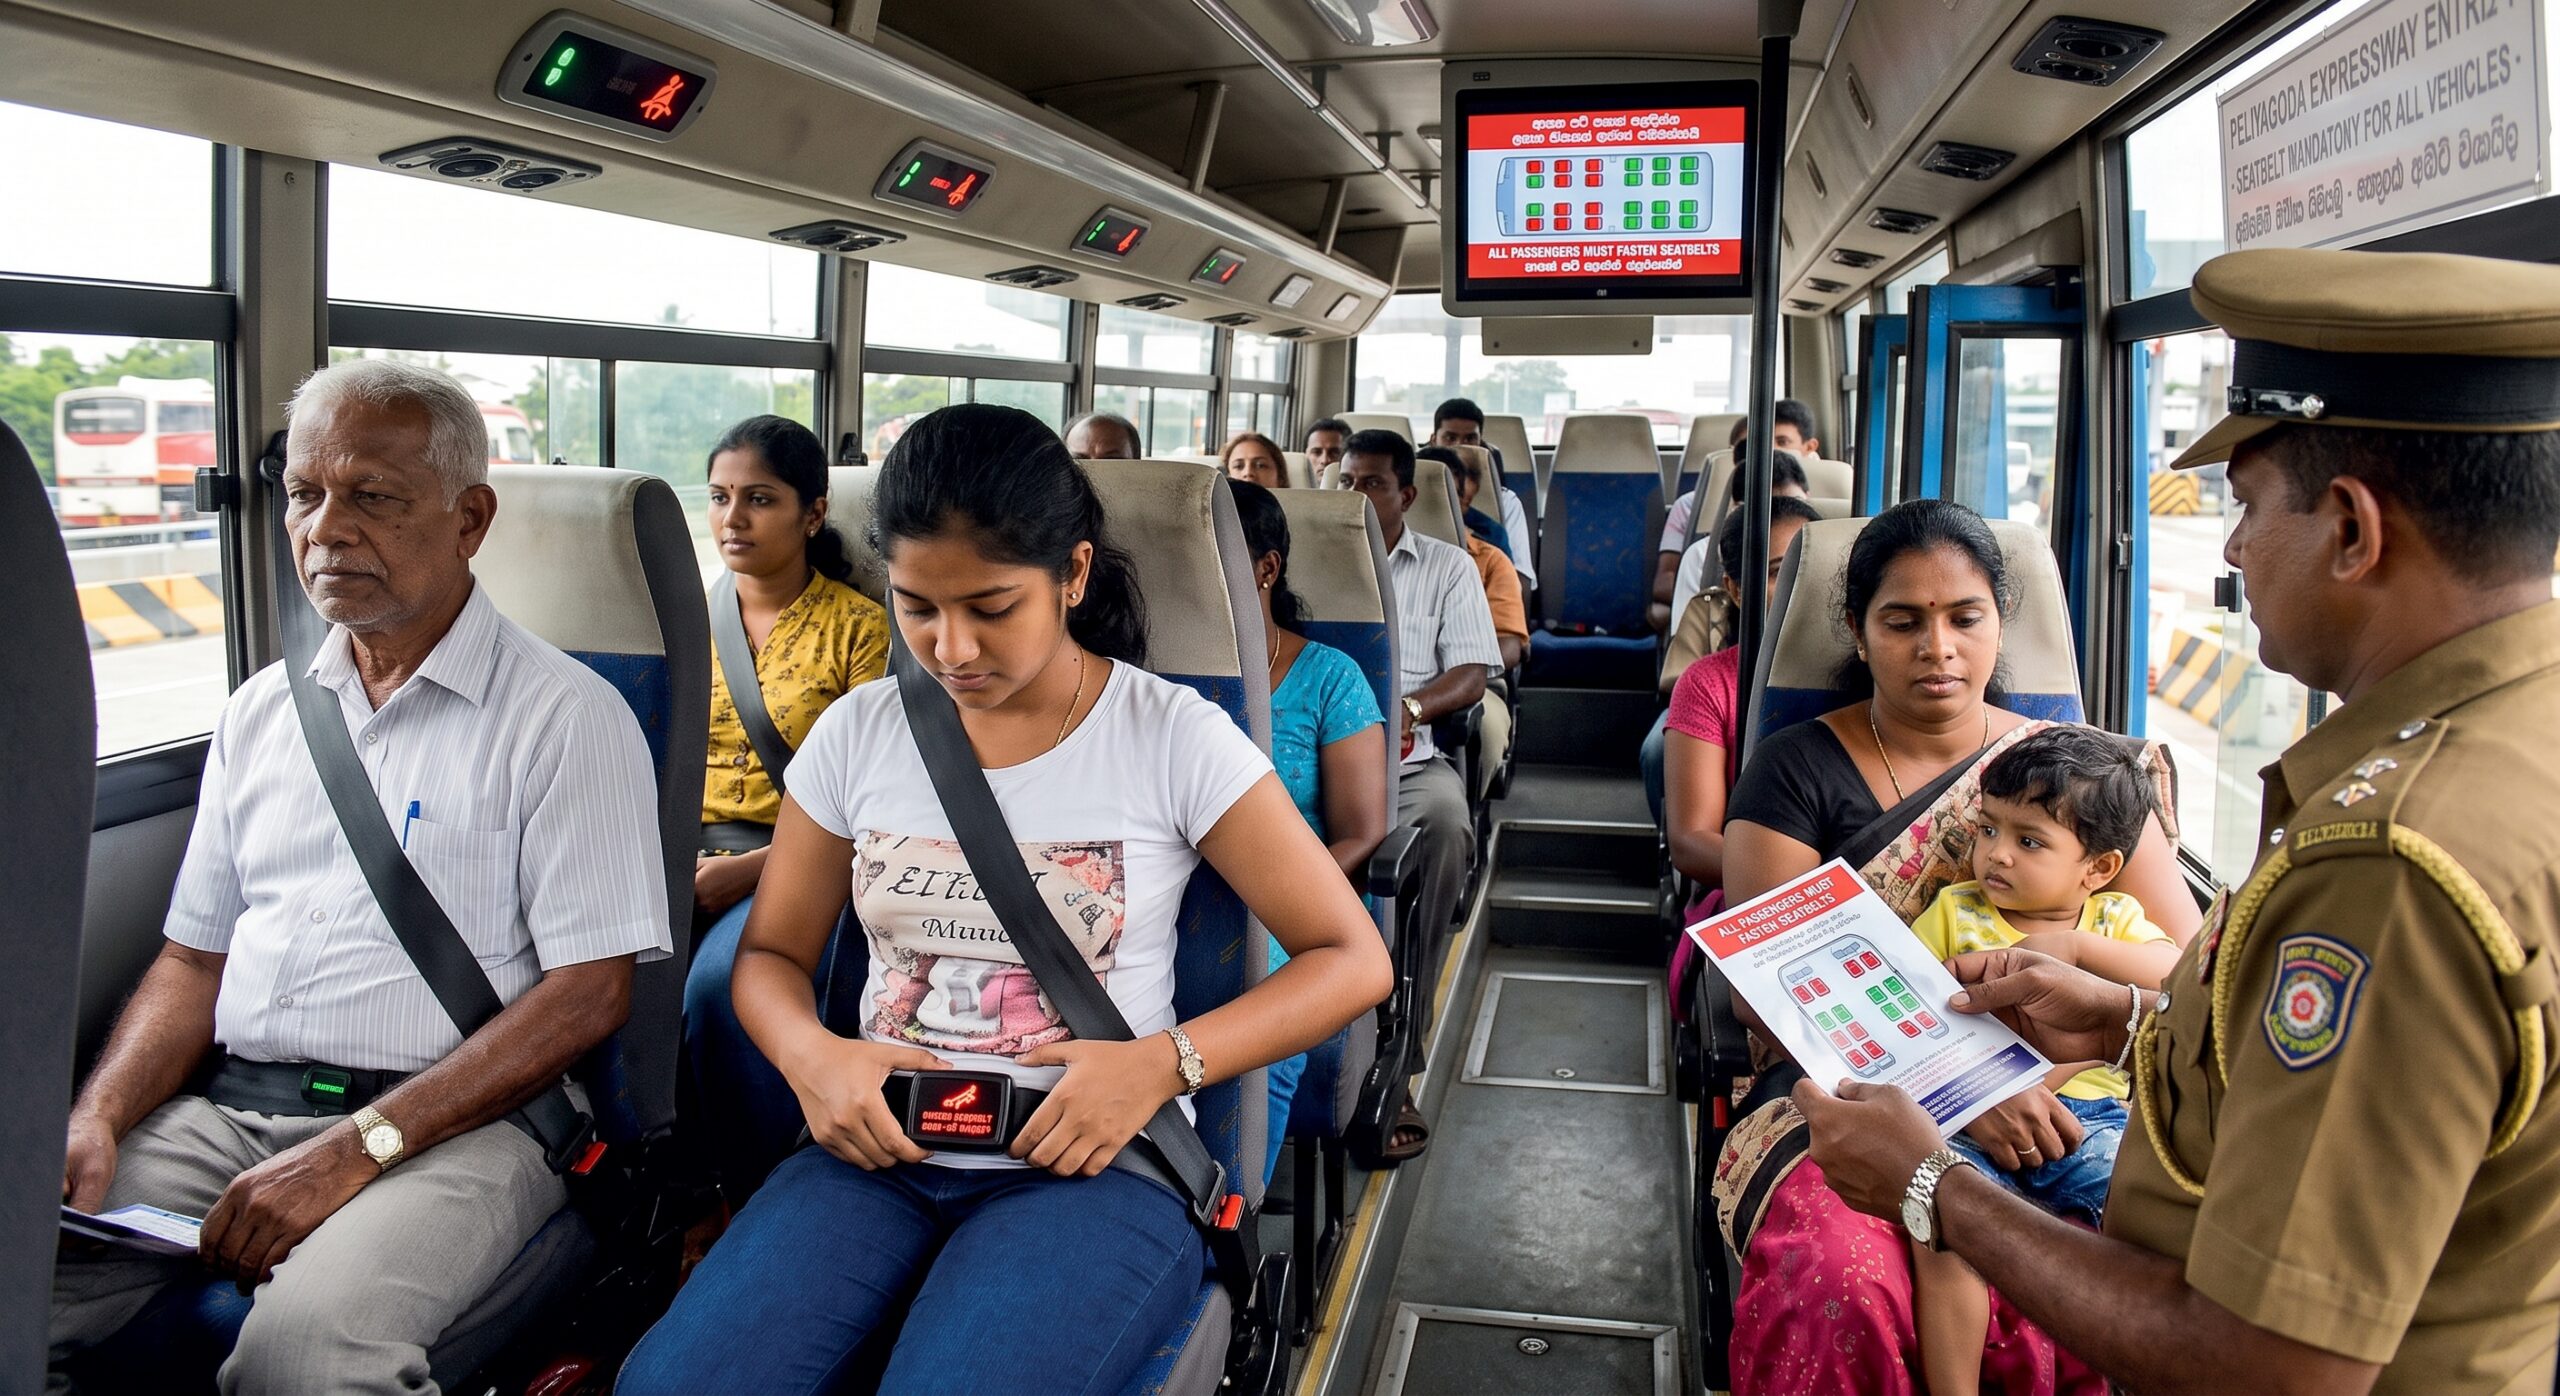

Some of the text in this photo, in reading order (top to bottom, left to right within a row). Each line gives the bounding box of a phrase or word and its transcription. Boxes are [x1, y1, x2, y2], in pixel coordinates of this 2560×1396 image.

[2230, 79, 2307, 150] PELIYAGODA
[2309, 12, 2419, 110] EXPRESSWAY
[2236, 147, 2286, 195] SEATBELT
[2363, 99, 2393, 143] FOR
[2395, 86, 2424, 130] ALL
[2426, 43, 2511, 116] VEHICLES
[1488, 243, 1720, 259] ALL PASSENGERS MUST FASTEN SEATBELTS
[1717, 923, 1742, 938] ALL
